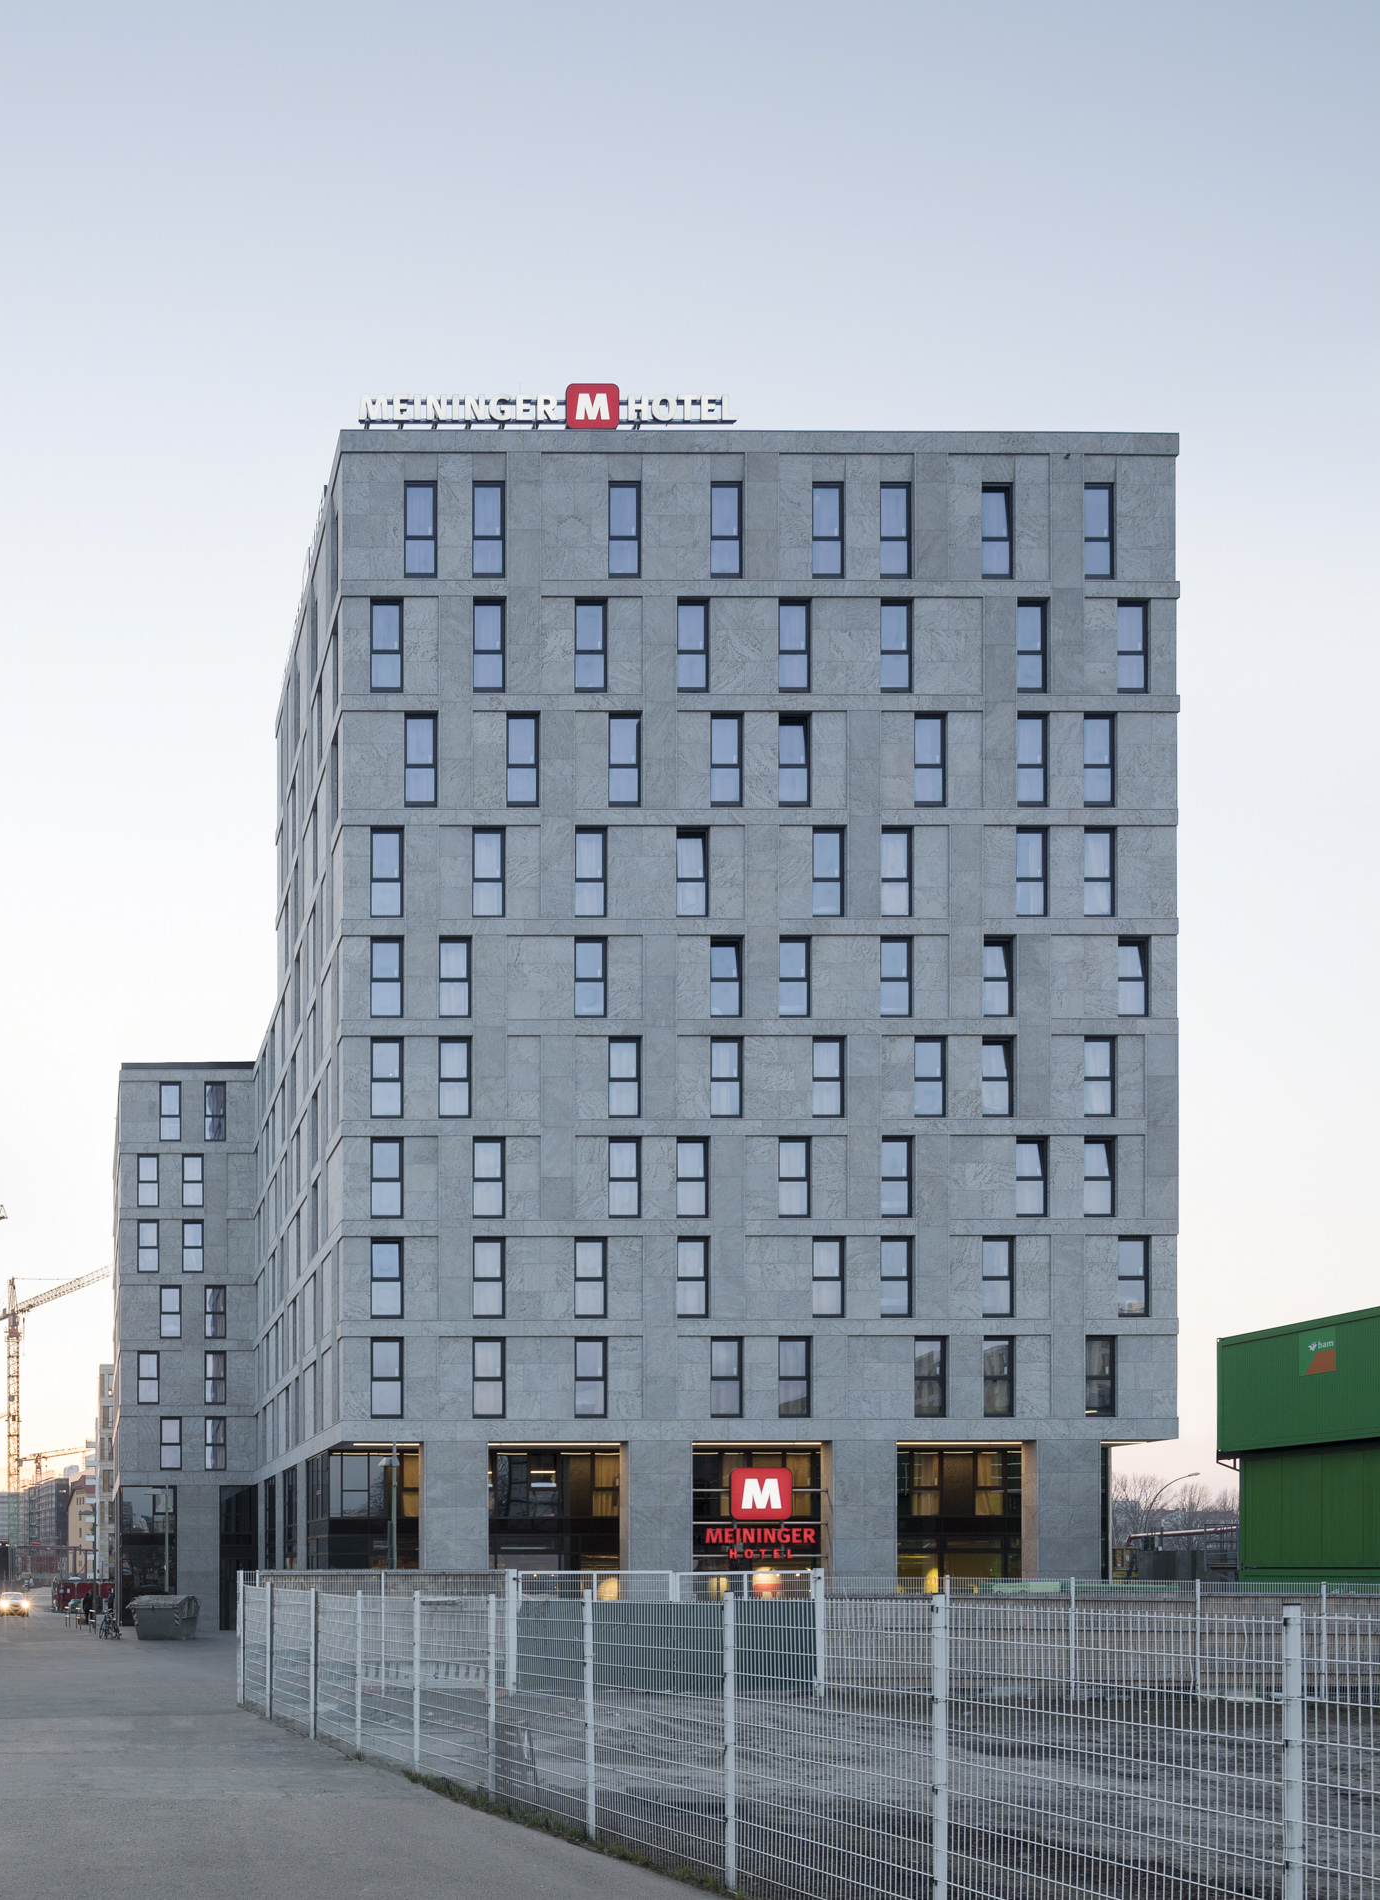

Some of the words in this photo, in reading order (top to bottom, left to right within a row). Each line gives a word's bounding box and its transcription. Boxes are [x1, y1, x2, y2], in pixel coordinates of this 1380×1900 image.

[358, 393, 559, 422] MEININGER
[575, 393, 610, 420] M
[627, 393, 739, 422] HOTEL
[1317, 1340, 1334, 1349] bam
[741, 1478, 782, 1509] M
[705, 1528, 816, 1544] MEININGER
[729, 1549, 794, 1559] HOTEL
